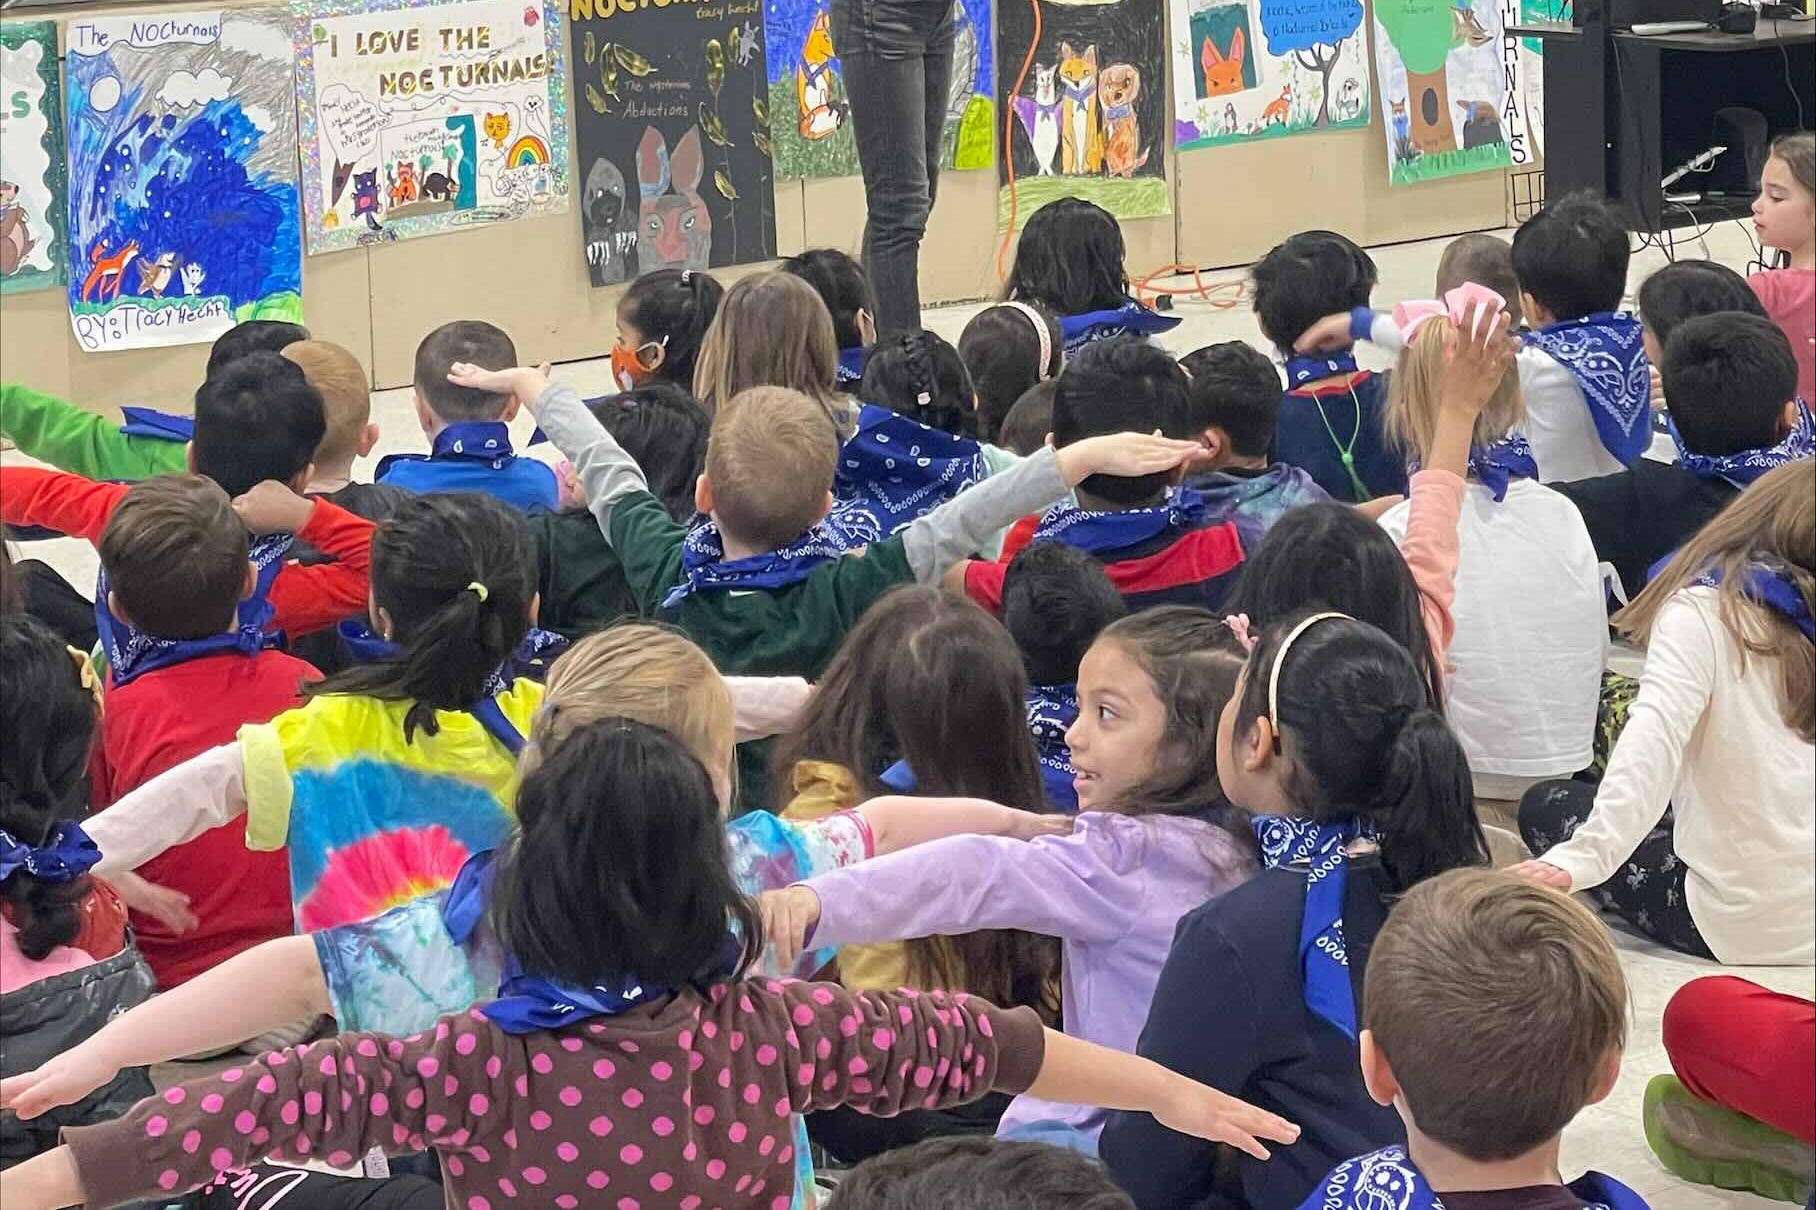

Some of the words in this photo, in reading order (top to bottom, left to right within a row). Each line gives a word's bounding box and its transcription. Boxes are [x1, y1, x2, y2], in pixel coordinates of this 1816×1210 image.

[75, 24, 109, 46] The
[331, 35, 337, 57] I
[355, 28, 420, 55] LOVE
[439, 26, 491, 51] THE
